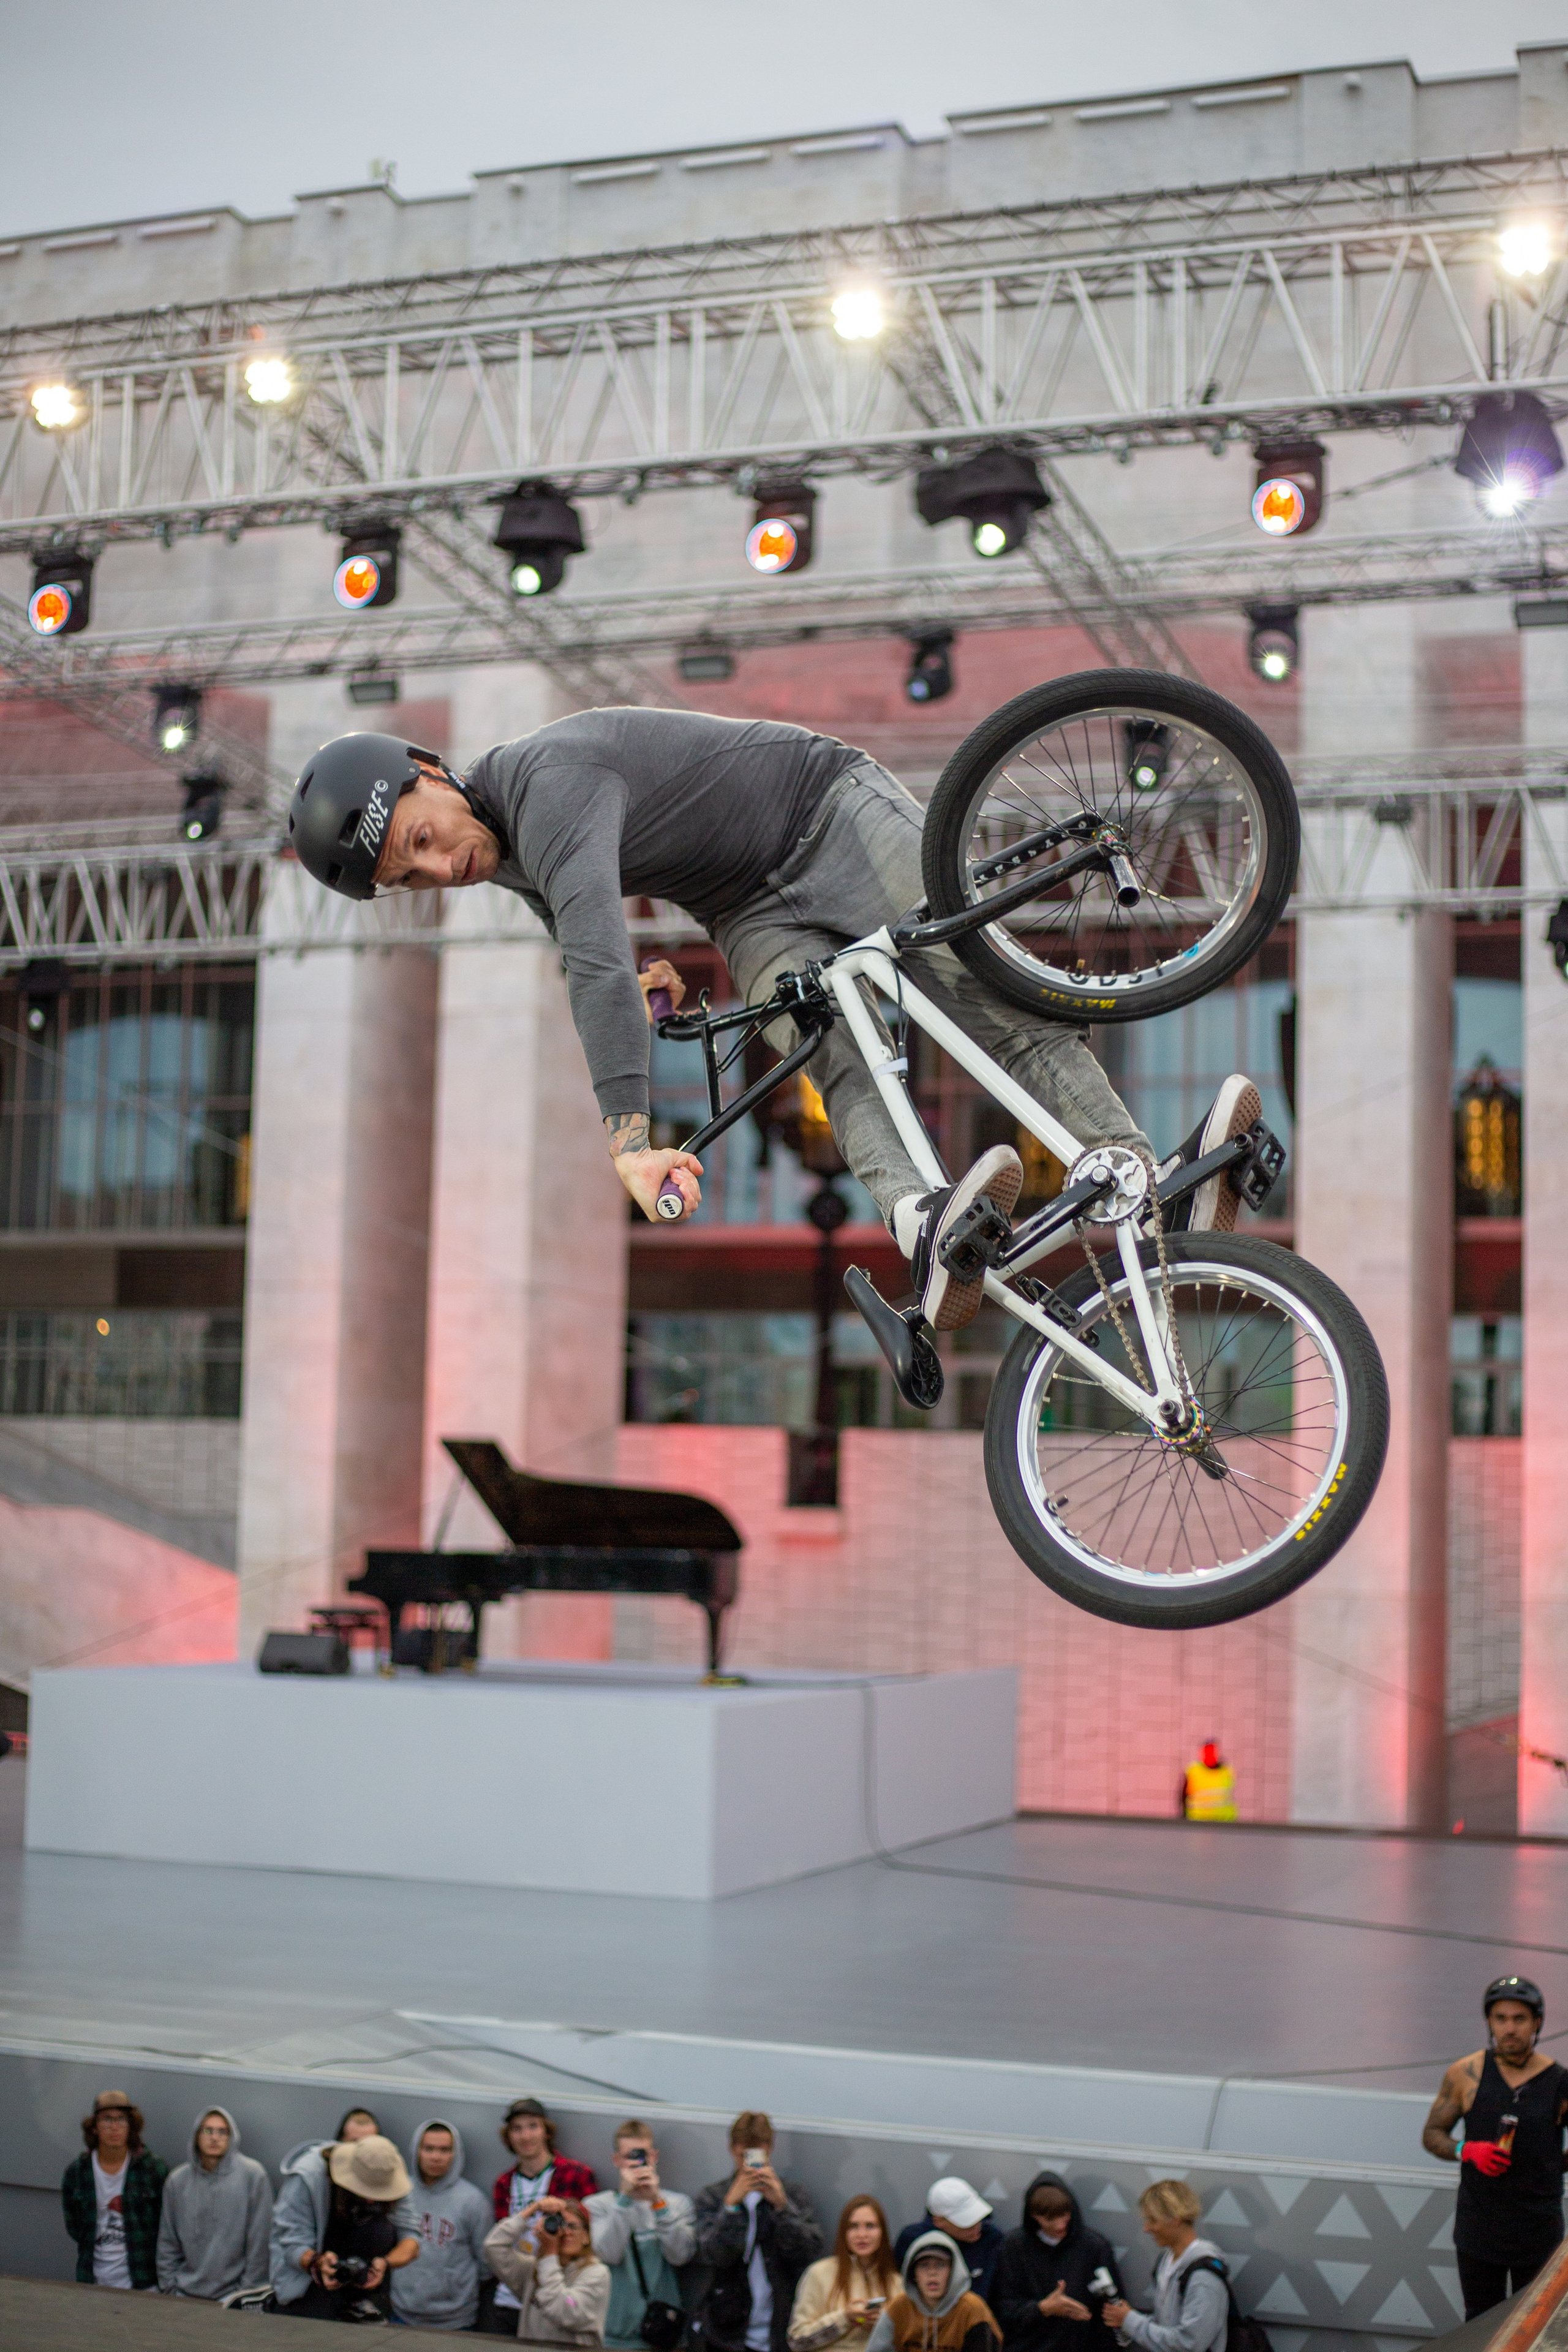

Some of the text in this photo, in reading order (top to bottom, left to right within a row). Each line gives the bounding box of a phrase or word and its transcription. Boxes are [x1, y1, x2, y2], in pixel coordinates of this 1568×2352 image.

[360, 790, 388, 858] FUSE
[663, 1199, 676, 1215] odi
[1295, 1462, 1348, 1541] MAXXIS
